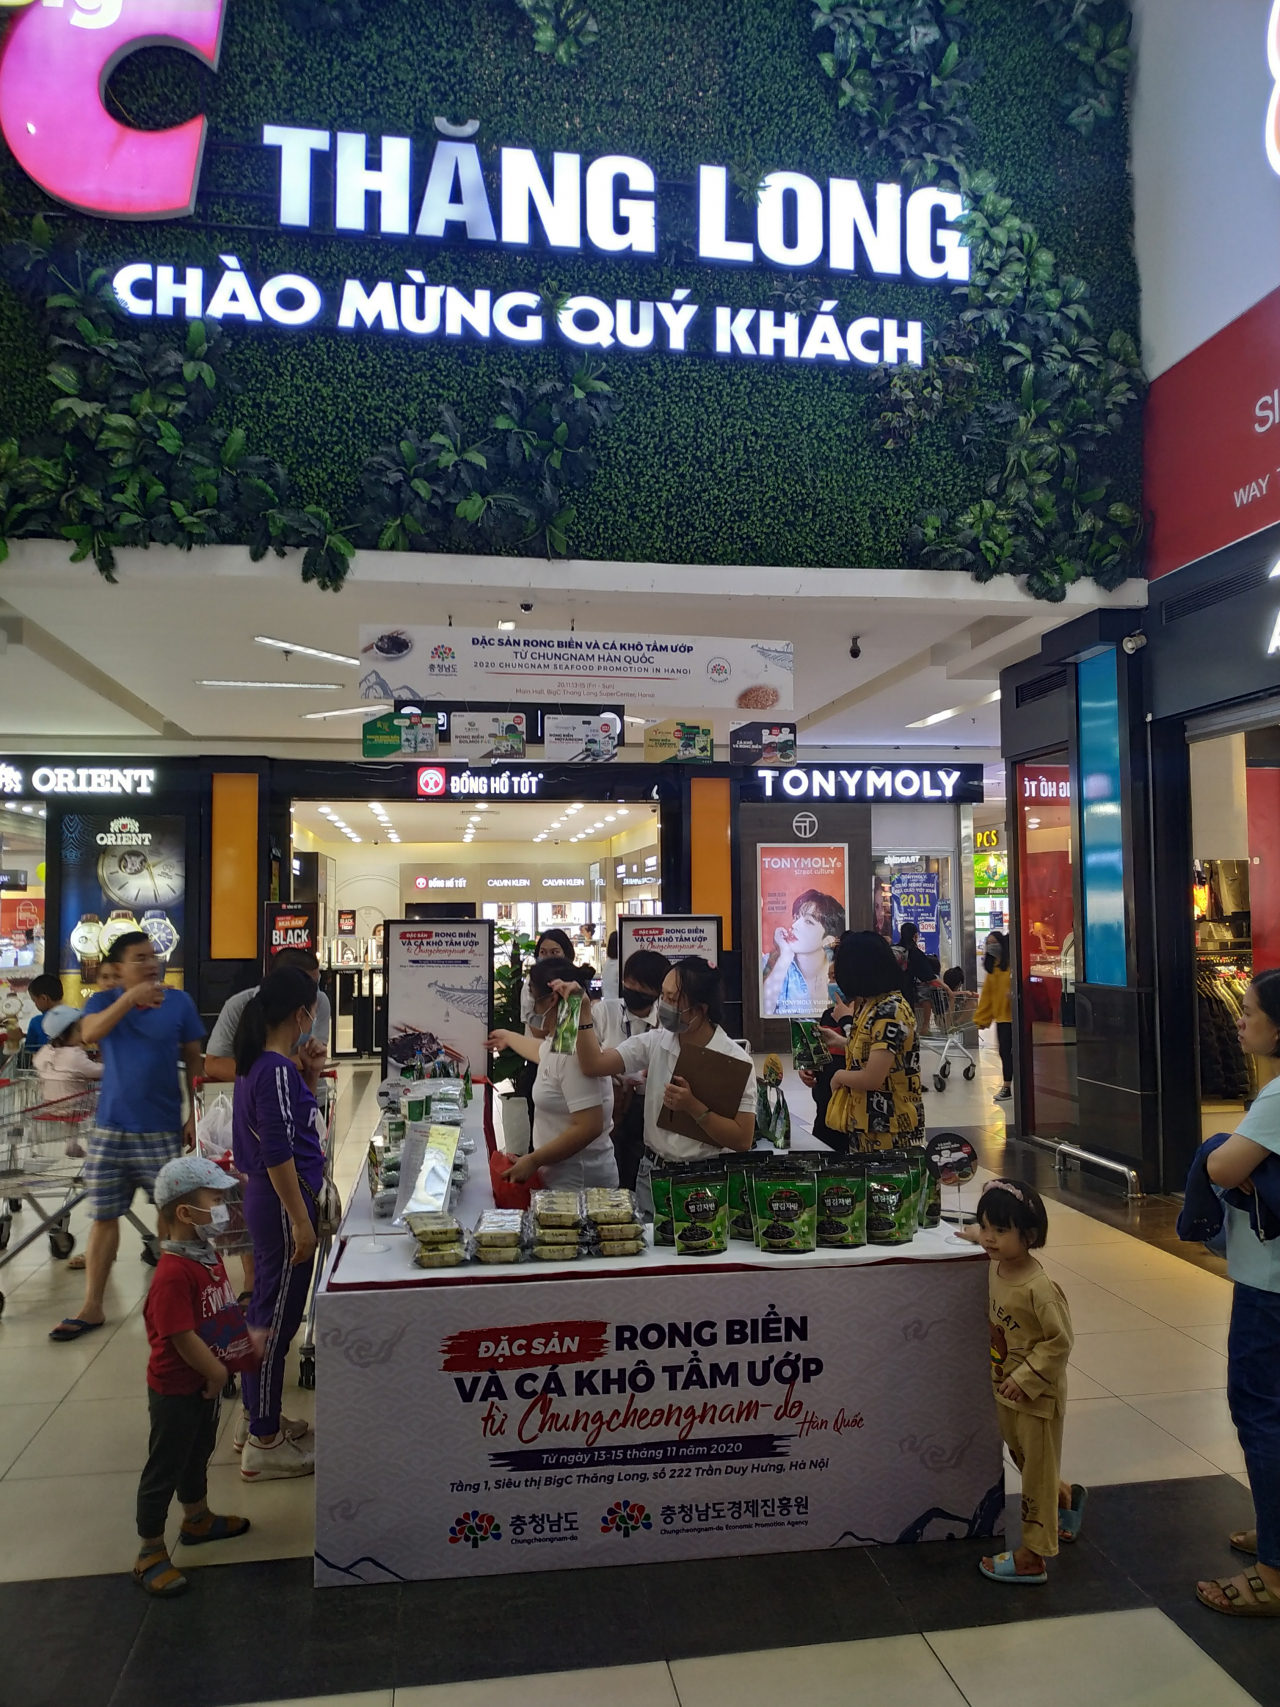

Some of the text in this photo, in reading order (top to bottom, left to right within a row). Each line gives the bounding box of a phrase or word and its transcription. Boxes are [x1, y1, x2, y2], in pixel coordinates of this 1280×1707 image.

[263, 116, 970, 281] THĂNG LONG
[113, 255, 923, 367] CHÀO MỪNG QUÝ KHÁCH
[1234, 474, 1270, 508] WAY
[471, 636, 495, 649] ĐẶC
[497, 636, 521, 648] SẢN
[523, 639, 554, 649] RONG
[557, 637, 582, 649] BIỂN
[585, 639, 600, 650] VÀ
[602, 640, 618, 650] CÁ
[620, 641, 643, 651] KHÔ
[670, 643, 694, 653] ƯỚP
[513, 649, 655, 664] TỪ CHUNGNAM HÀN QUỐC
[499, 662, 550, 670] CHUNGNAM
[597, 665, 649, 673] PROMOTION
[546, 689, 561, 697] BigC
[32, 768, 155, 793] ORIENT
[450, 770, 538, 794] ĐỒNG HỒ TỐT
[758, 769, 962, 797] TONYMOLY
[96, 833, 152, 846] ORIENT
[976, 829, 997, 848] PCS
[487, 879, 531, 887] CALVIN KLEIN
[542, 879, 585, 887] CALVIN KLEIN
[900, 893, 931, 907] 20.11
[458, 930, 477, 939] BIỂN
[687, 926, 705, 934] BIỂN
[920, 923, 935, 931] 30%
[272, 928, 310, 945] BLACK
[401, 938, 413, 947] VÀ
[413, 938, 425, 947] CÁ
[426, 938, 443, 947] KHÔ
[463, 939, 480, 947] ƯỚP
[635, 935, 645, 943] VÀ
[646, 935, 657, 943] CÁ
[657, 934, 674, 943] KHÔ
[478, 1303, 808, 1363] ĐẶC SẢN RONG BIỂN
[454, 1350, 824, 1403] VÀ CÁ KHÔ TẨM ƯỚP
[481, 1380, 865, 1447] từ Chungcheongnam-do Hàn Quốc
[542, 1442, 743, 1465] Từ ngày 13-15 tháng 11 năm 2020
[450, 1457, 830, 1493] Tầng 1, Siêu thị BigC Thăng Long, số 222 Trần Duy Hưng, Hà Nội
[509, 1495, 809, 1536] 충청남도 충청남도경제진흥원
[510, 1518, 809, 1545] Chungcheongnam-do Chungcheongnam-do Economic Promotion Agency
